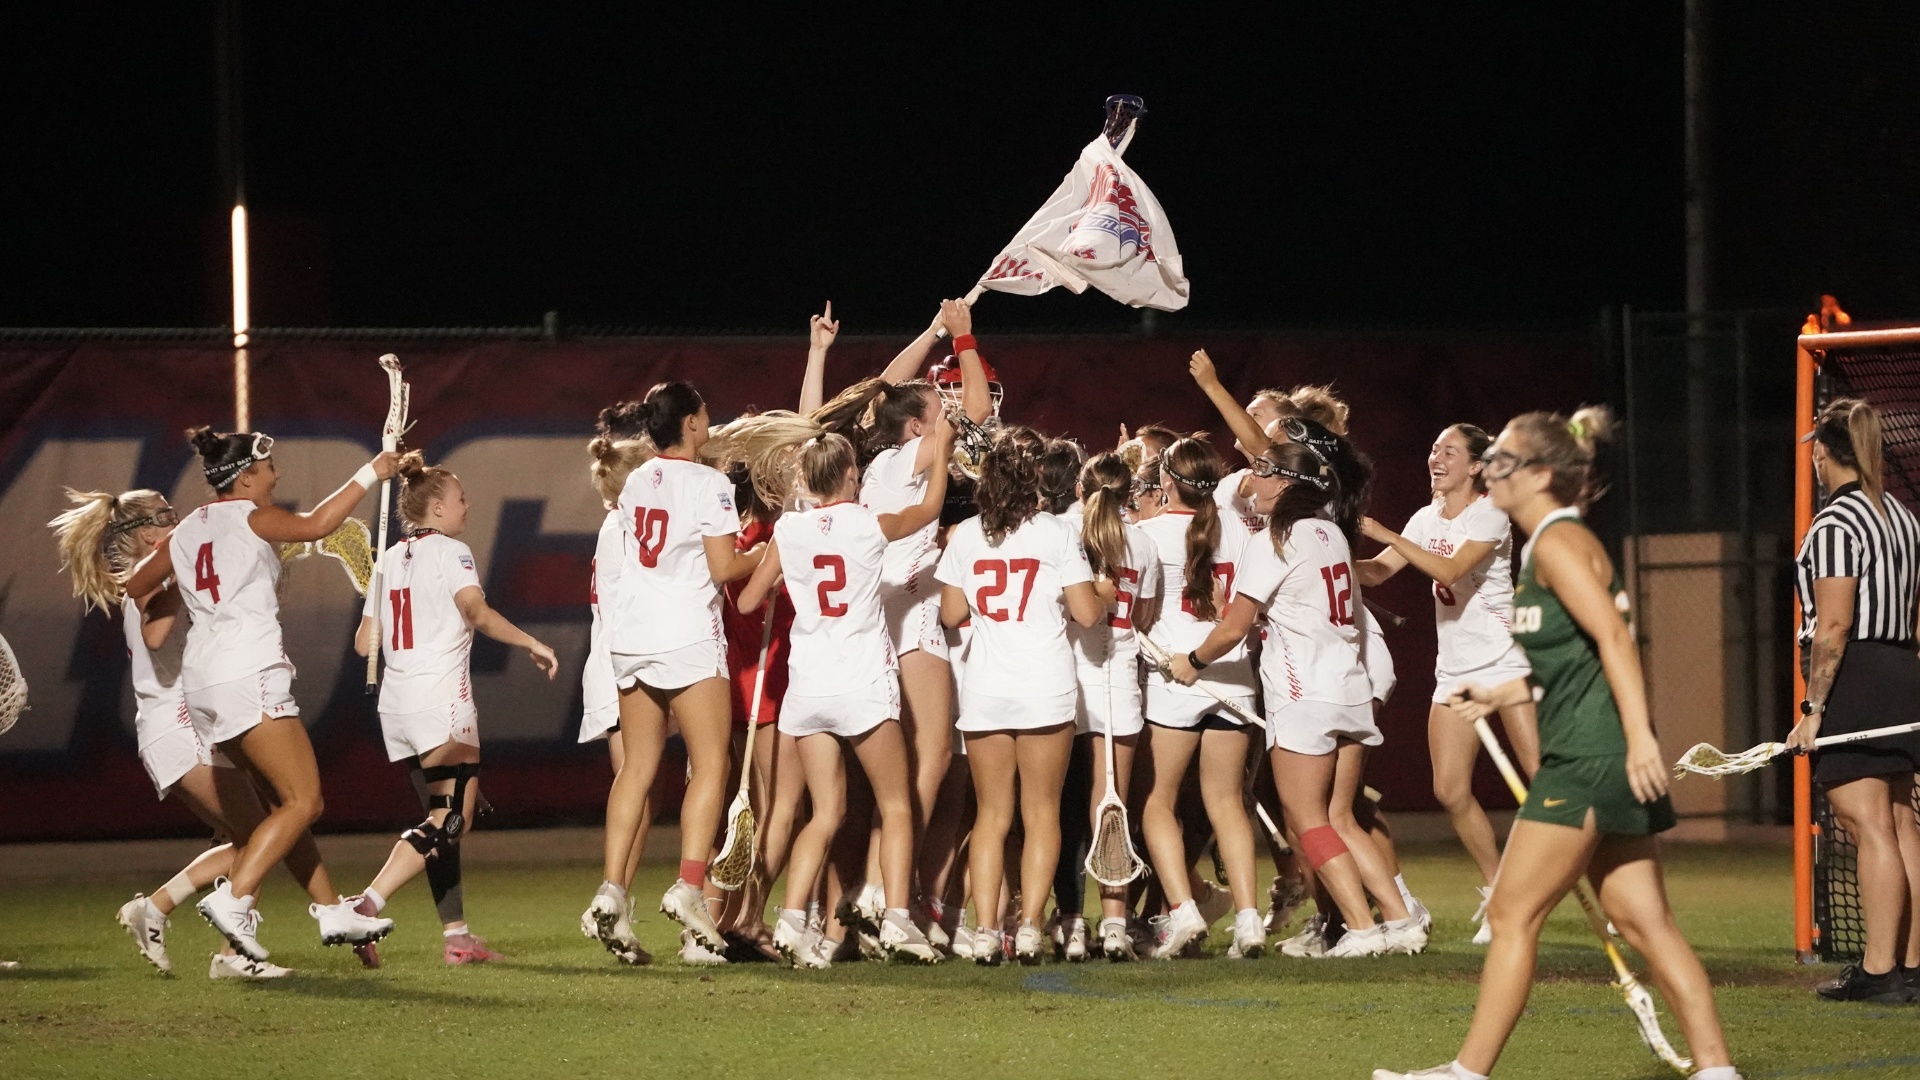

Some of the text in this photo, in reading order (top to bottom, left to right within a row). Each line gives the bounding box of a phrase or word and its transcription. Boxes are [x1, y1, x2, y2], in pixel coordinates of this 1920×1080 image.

[1281, 469, 1298, 478] GAIT
[380, 511, 388, 531] GAIT
[634, 506, 669, 569] 10
[195, 542, 221, 605] 4
[813, 554, 848, 617] 2
[973, 558, 1040, 622] 27
[1107, 566, 1139, 630] 5
[1320, 561, 1355, 628] 12
[390, 587, 414, 651] 11
[1224, 699, 1242, 711] GAIT
